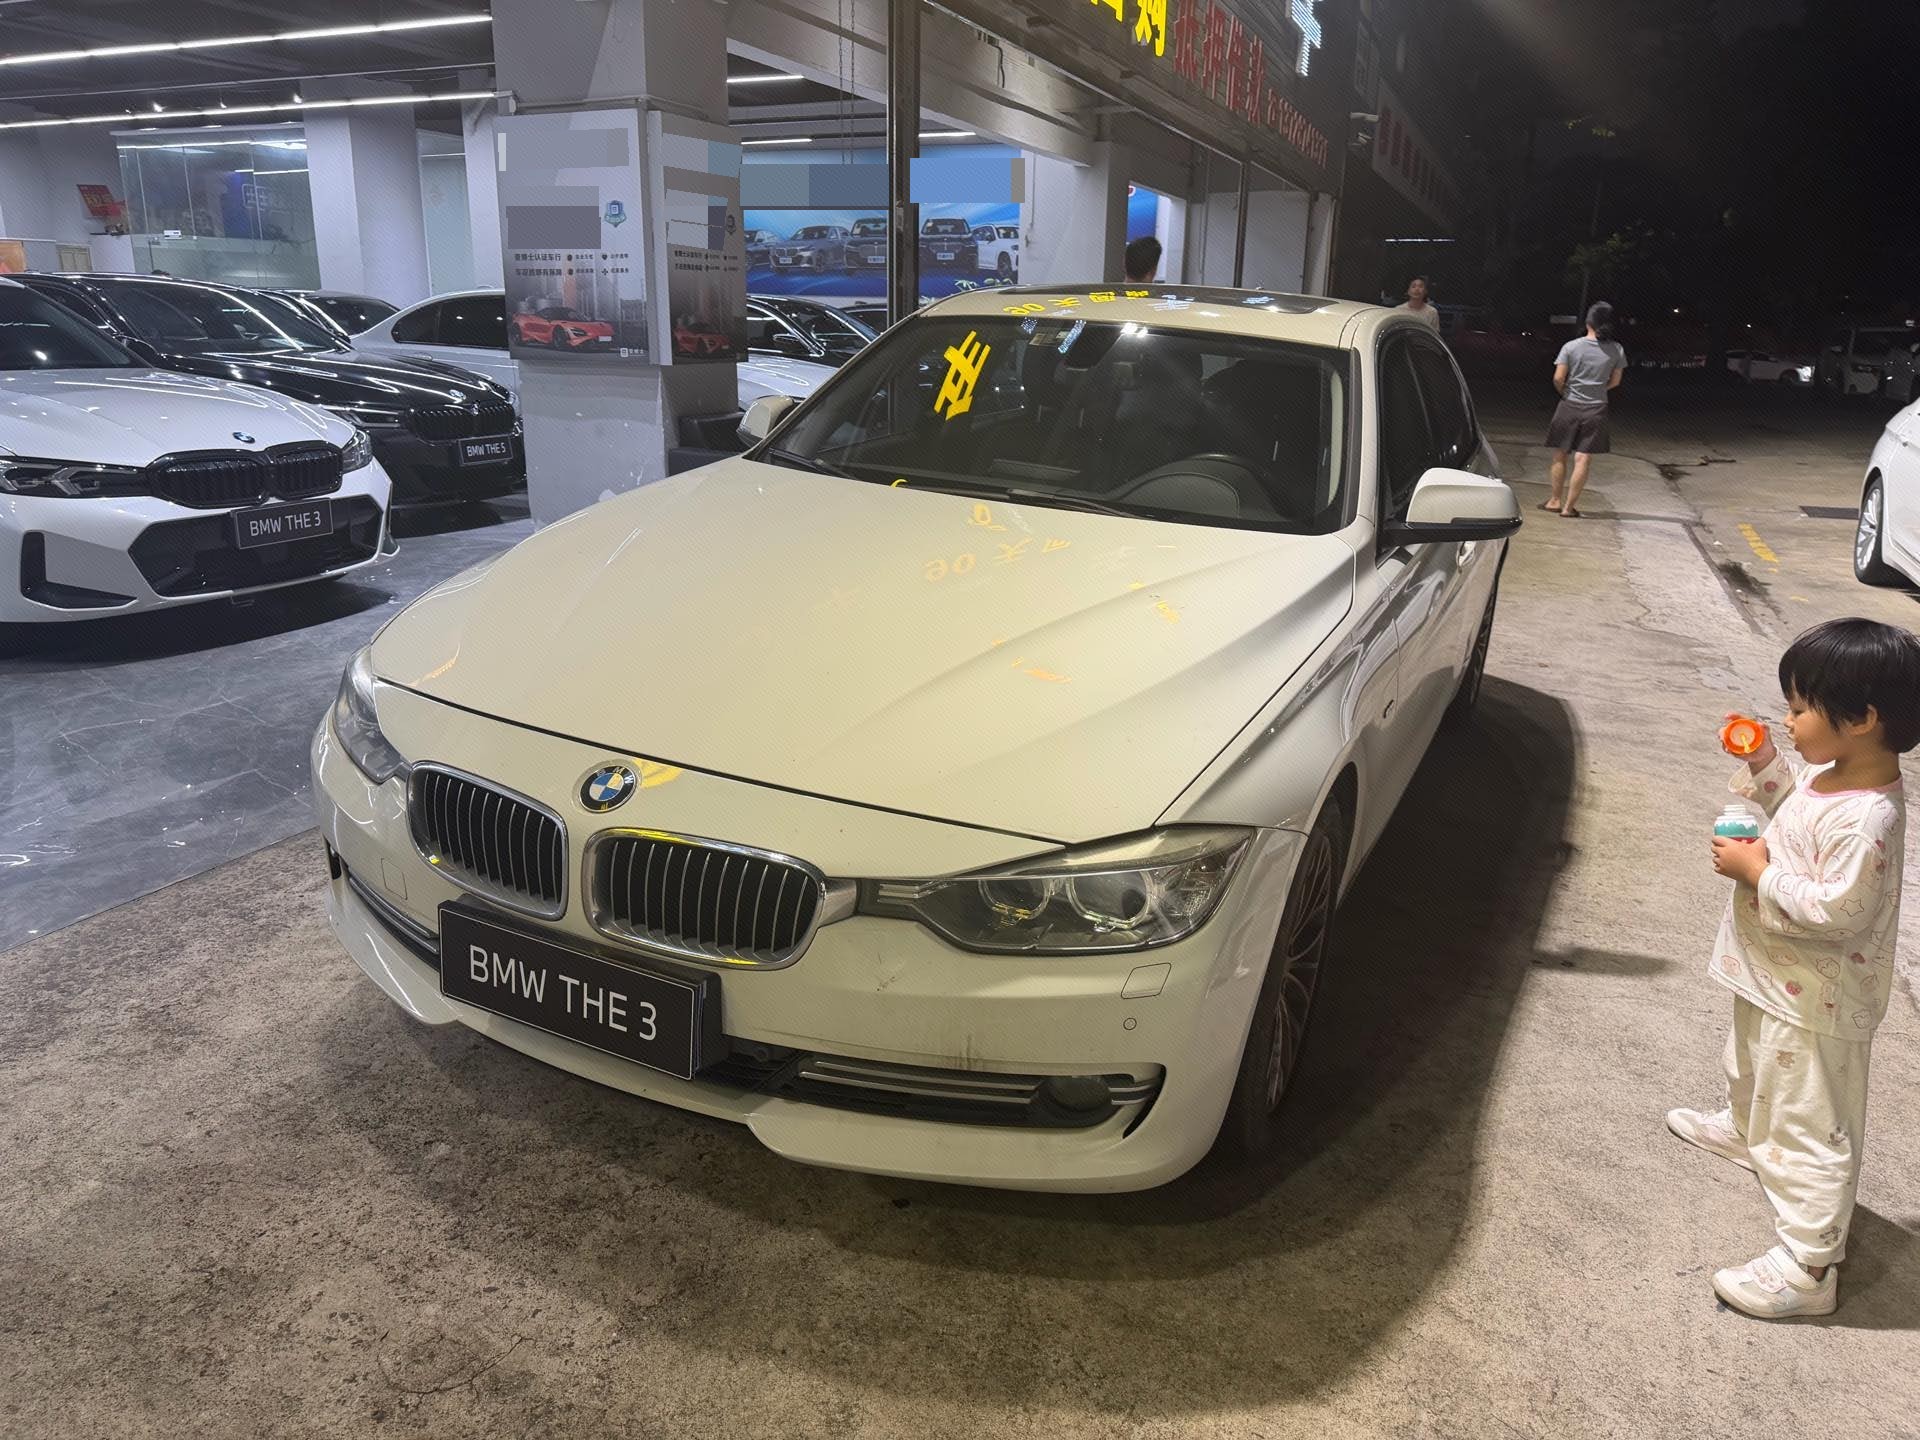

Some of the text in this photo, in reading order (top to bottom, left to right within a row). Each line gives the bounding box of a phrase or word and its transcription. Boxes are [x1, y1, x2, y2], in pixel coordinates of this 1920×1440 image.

[466, 442, 506, 457] BMW THE 5
[249, 511, 321, 536] BMW THE 3
[469, 944, 657, 1041] BMW THE 3
